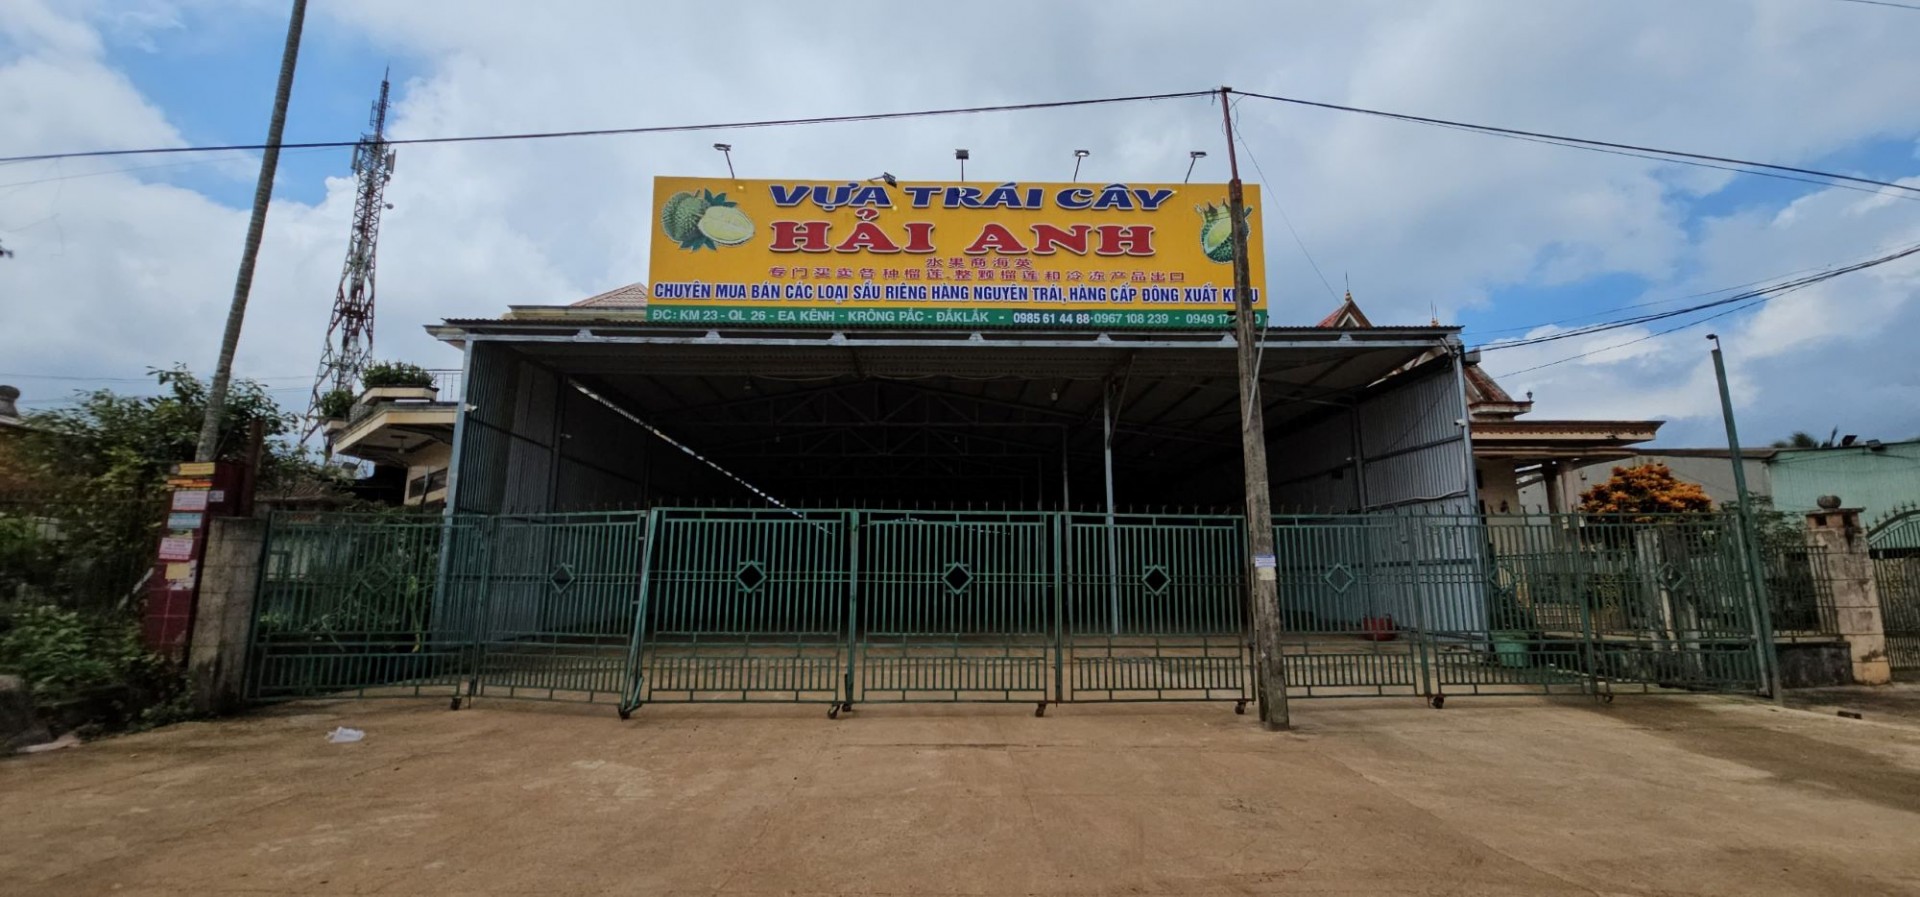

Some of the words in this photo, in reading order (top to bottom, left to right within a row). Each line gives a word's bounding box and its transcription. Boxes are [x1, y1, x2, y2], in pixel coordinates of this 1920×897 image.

[769, 183, 892, 211] VỰA
[904, 182, 1044, 210] TRÁI
[1056, 183, 1175, 211] CÂY
[769, 208, 937, 253] HẢI
[964, 222, 1156, 256] ANH
[926, 257, 1032, 269] 水果商海英
[654, 281, 711, 298] CHUYÊN
[715, 284, 747, 299] MUA
[751, 281, 781, 299] BÁN
[785, 281, 814, 299] CÁC
[817, 285, 848, 304] LOẠI
[885, 283, 927, 300] RIÊNG
[931, 283, 970, 300] HÀNG
[973, 284, 1029, 301] NGUYÊN
[1032, 284, 1067, 303] TRÁI,
[1069, 284, 1107, 302] HÀNG
[1110, 282, 1138, 302] CẤP
[1142, 285, 1179, 302] ĐÔNG
[1184, 283, 1218, 302] XUẤT
[652, 309, 677, 320] ĐC:
[680, 310, 700, 320] KM
[703, 310, 718, 321] 23
[728, 310, 746, 321] QL
[750, 311, 766, 321] 26
[778, 311, 796, 321] EA
[800, 309, 835, 321] KÊNH
[848, 309, 895, 322] KRÔNG
[1013, 312, 1041, 324] 0985
[1042, 313, 1055, 324] 61
[1059, 313, 1073, 324] 44
[1126, 313, 1144, 324] 108
[1147, 313, 1169, 324] 239
[1186, 314, 1214, 324] 0949
